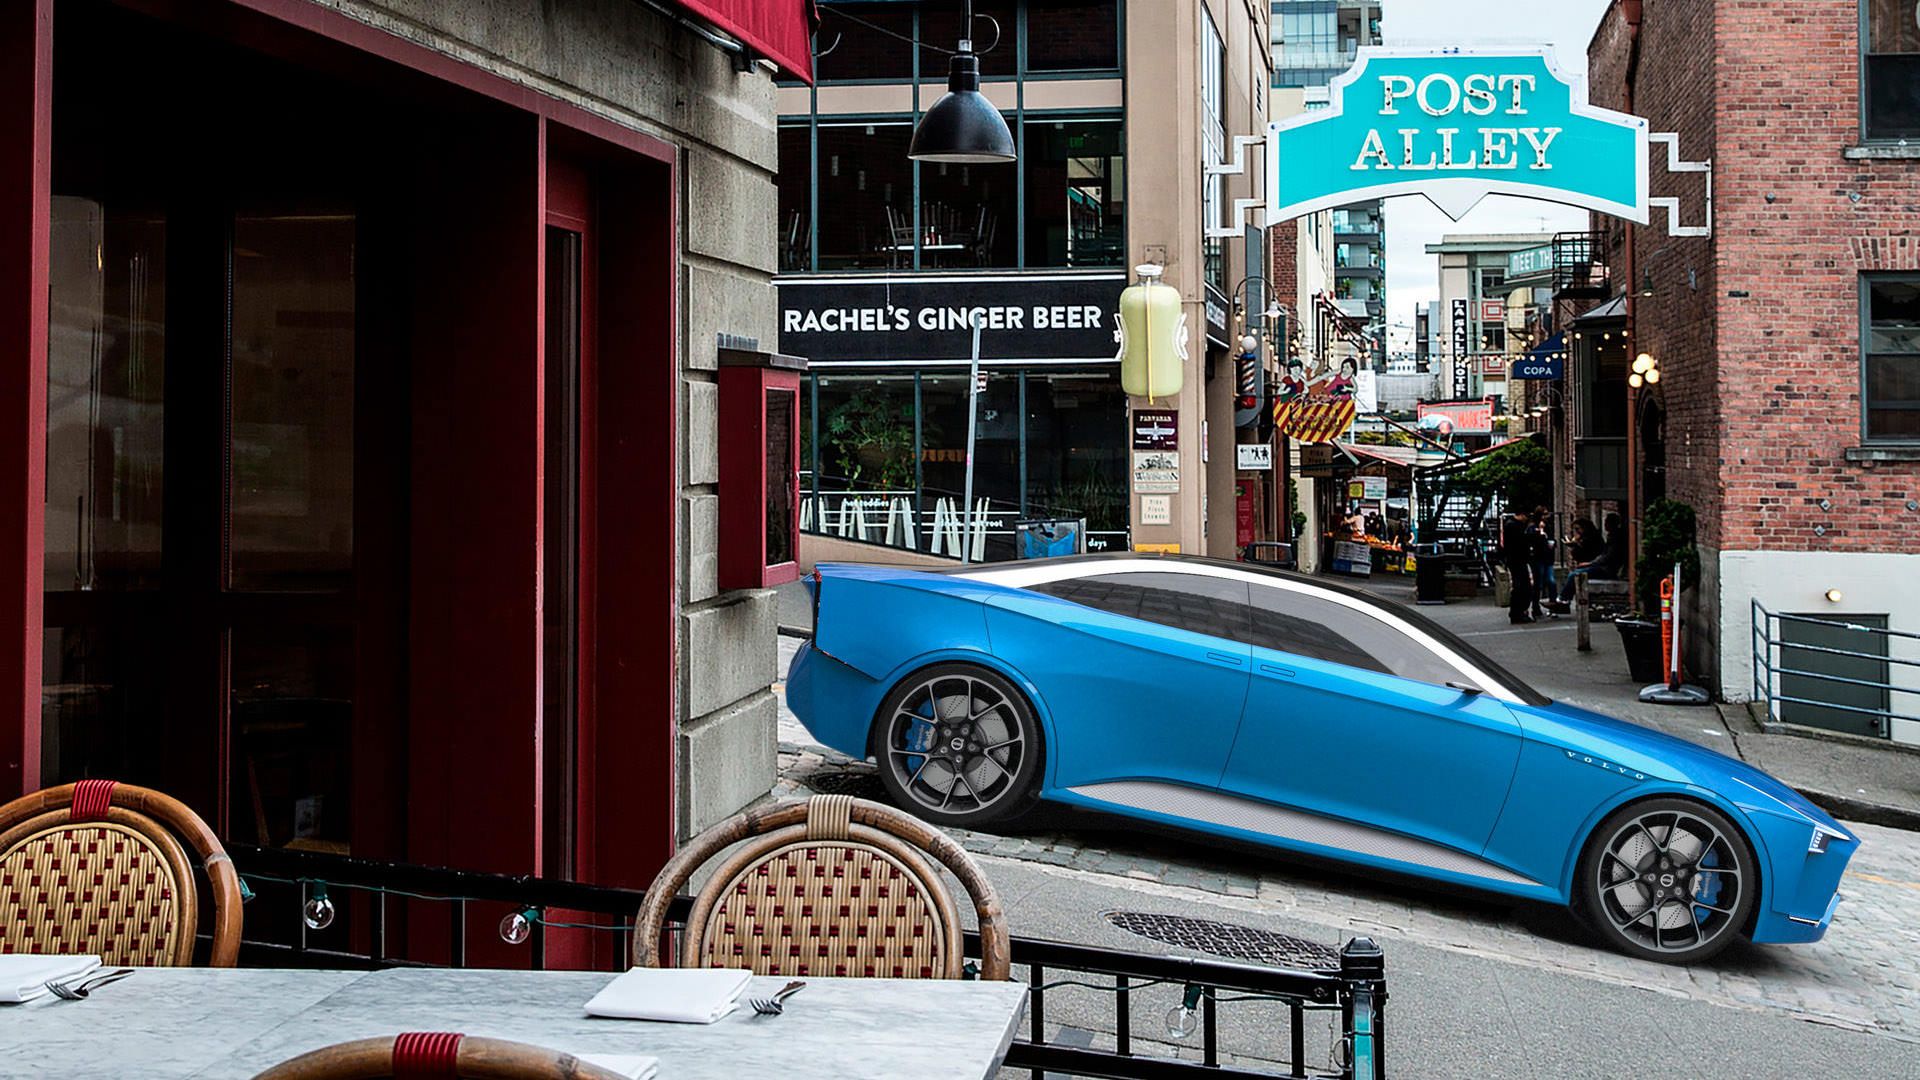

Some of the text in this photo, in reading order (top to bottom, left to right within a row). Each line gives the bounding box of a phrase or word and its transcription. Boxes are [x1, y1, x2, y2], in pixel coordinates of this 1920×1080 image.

[1378, 73, 1536, 116] POST
[1350, 127, 1562, 170] ALLEY
[1512, 251, 1535, 272] MEET
[784, 304, 1101, 332] RACHEL'S GINGER BEER
[1454, 300, 1464, 316] LA
[1523, 366, 1552, 375] COPA
[1567, 751, 1644, 780] VOLVO
